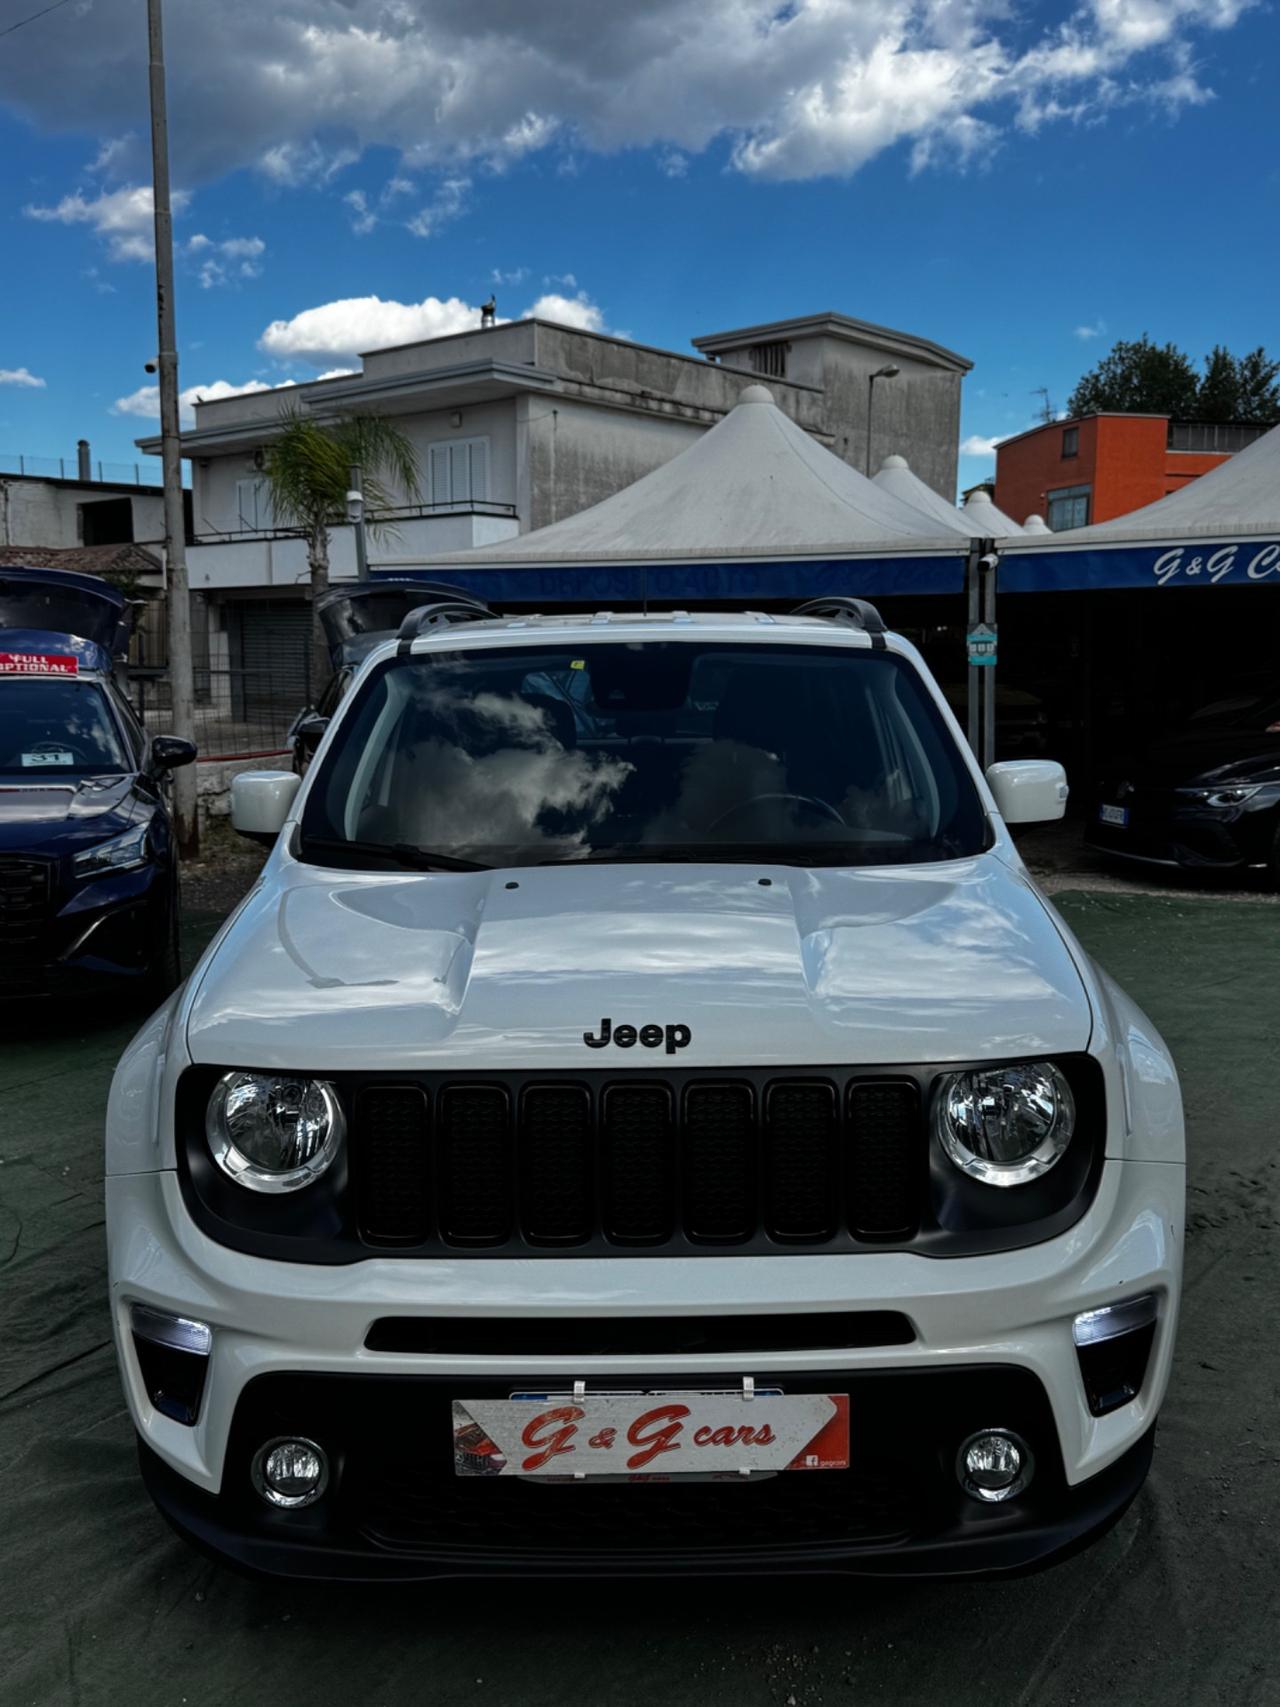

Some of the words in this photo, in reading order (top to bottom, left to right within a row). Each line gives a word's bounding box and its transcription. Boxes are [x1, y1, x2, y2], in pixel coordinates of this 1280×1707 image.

[1246, 544, 1280, 579] C
[583, 1018, 692, 1054] Jeep
[693, 1424, 776, 1447] cars
